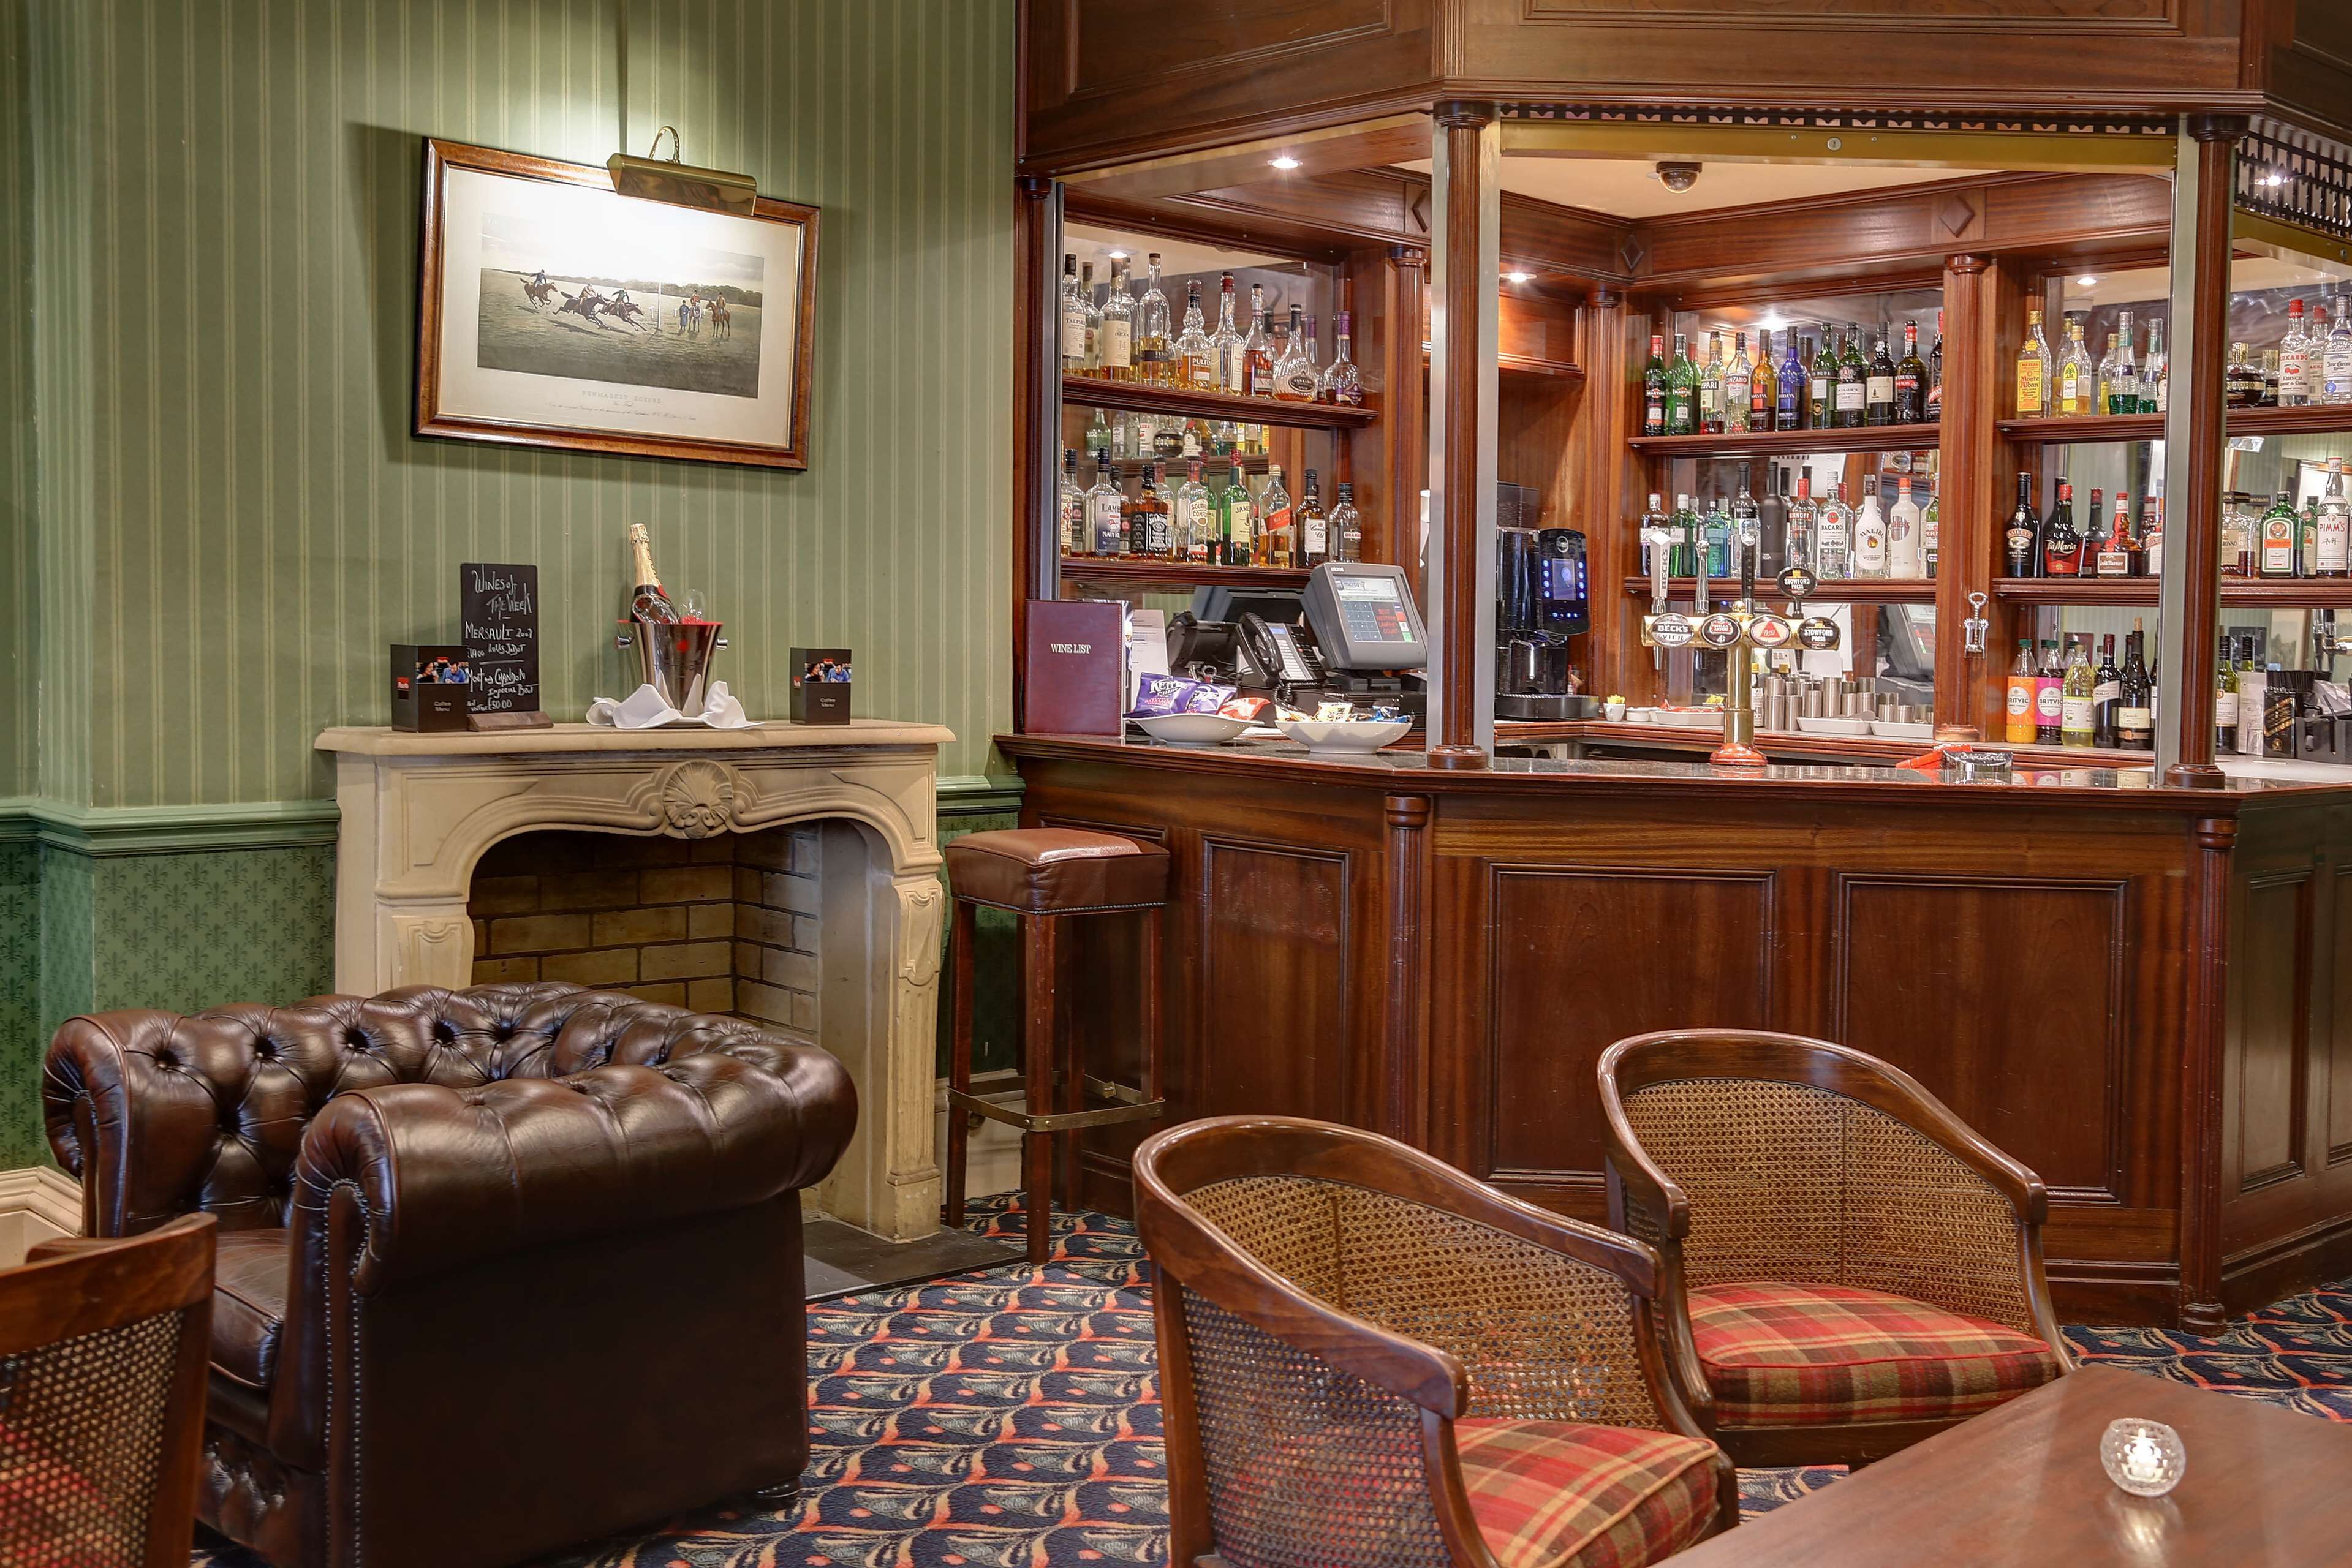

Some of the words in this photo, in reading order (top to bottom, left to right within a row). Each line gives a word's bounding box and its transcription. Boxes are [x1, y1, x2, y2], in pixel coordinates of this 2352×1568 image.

[581, 390, 628, 401] NEWMARKET
[634, 396, 662, 404] SCENES
[2318, 521, 2345, 532] PIMM'S
[471, 564, 506, 594] WINES
[505, 574, 518, 595] of
[485, 594, 507, 620] THE
[506, 582, 532, 616] WEEK
[1657, 624, 1688, 633] BECK'S
[1050, 643, 1073, 654] WINE
[1073, 644, 1091, 654] LIST
[494, 667, 526, 687] CHANDON
